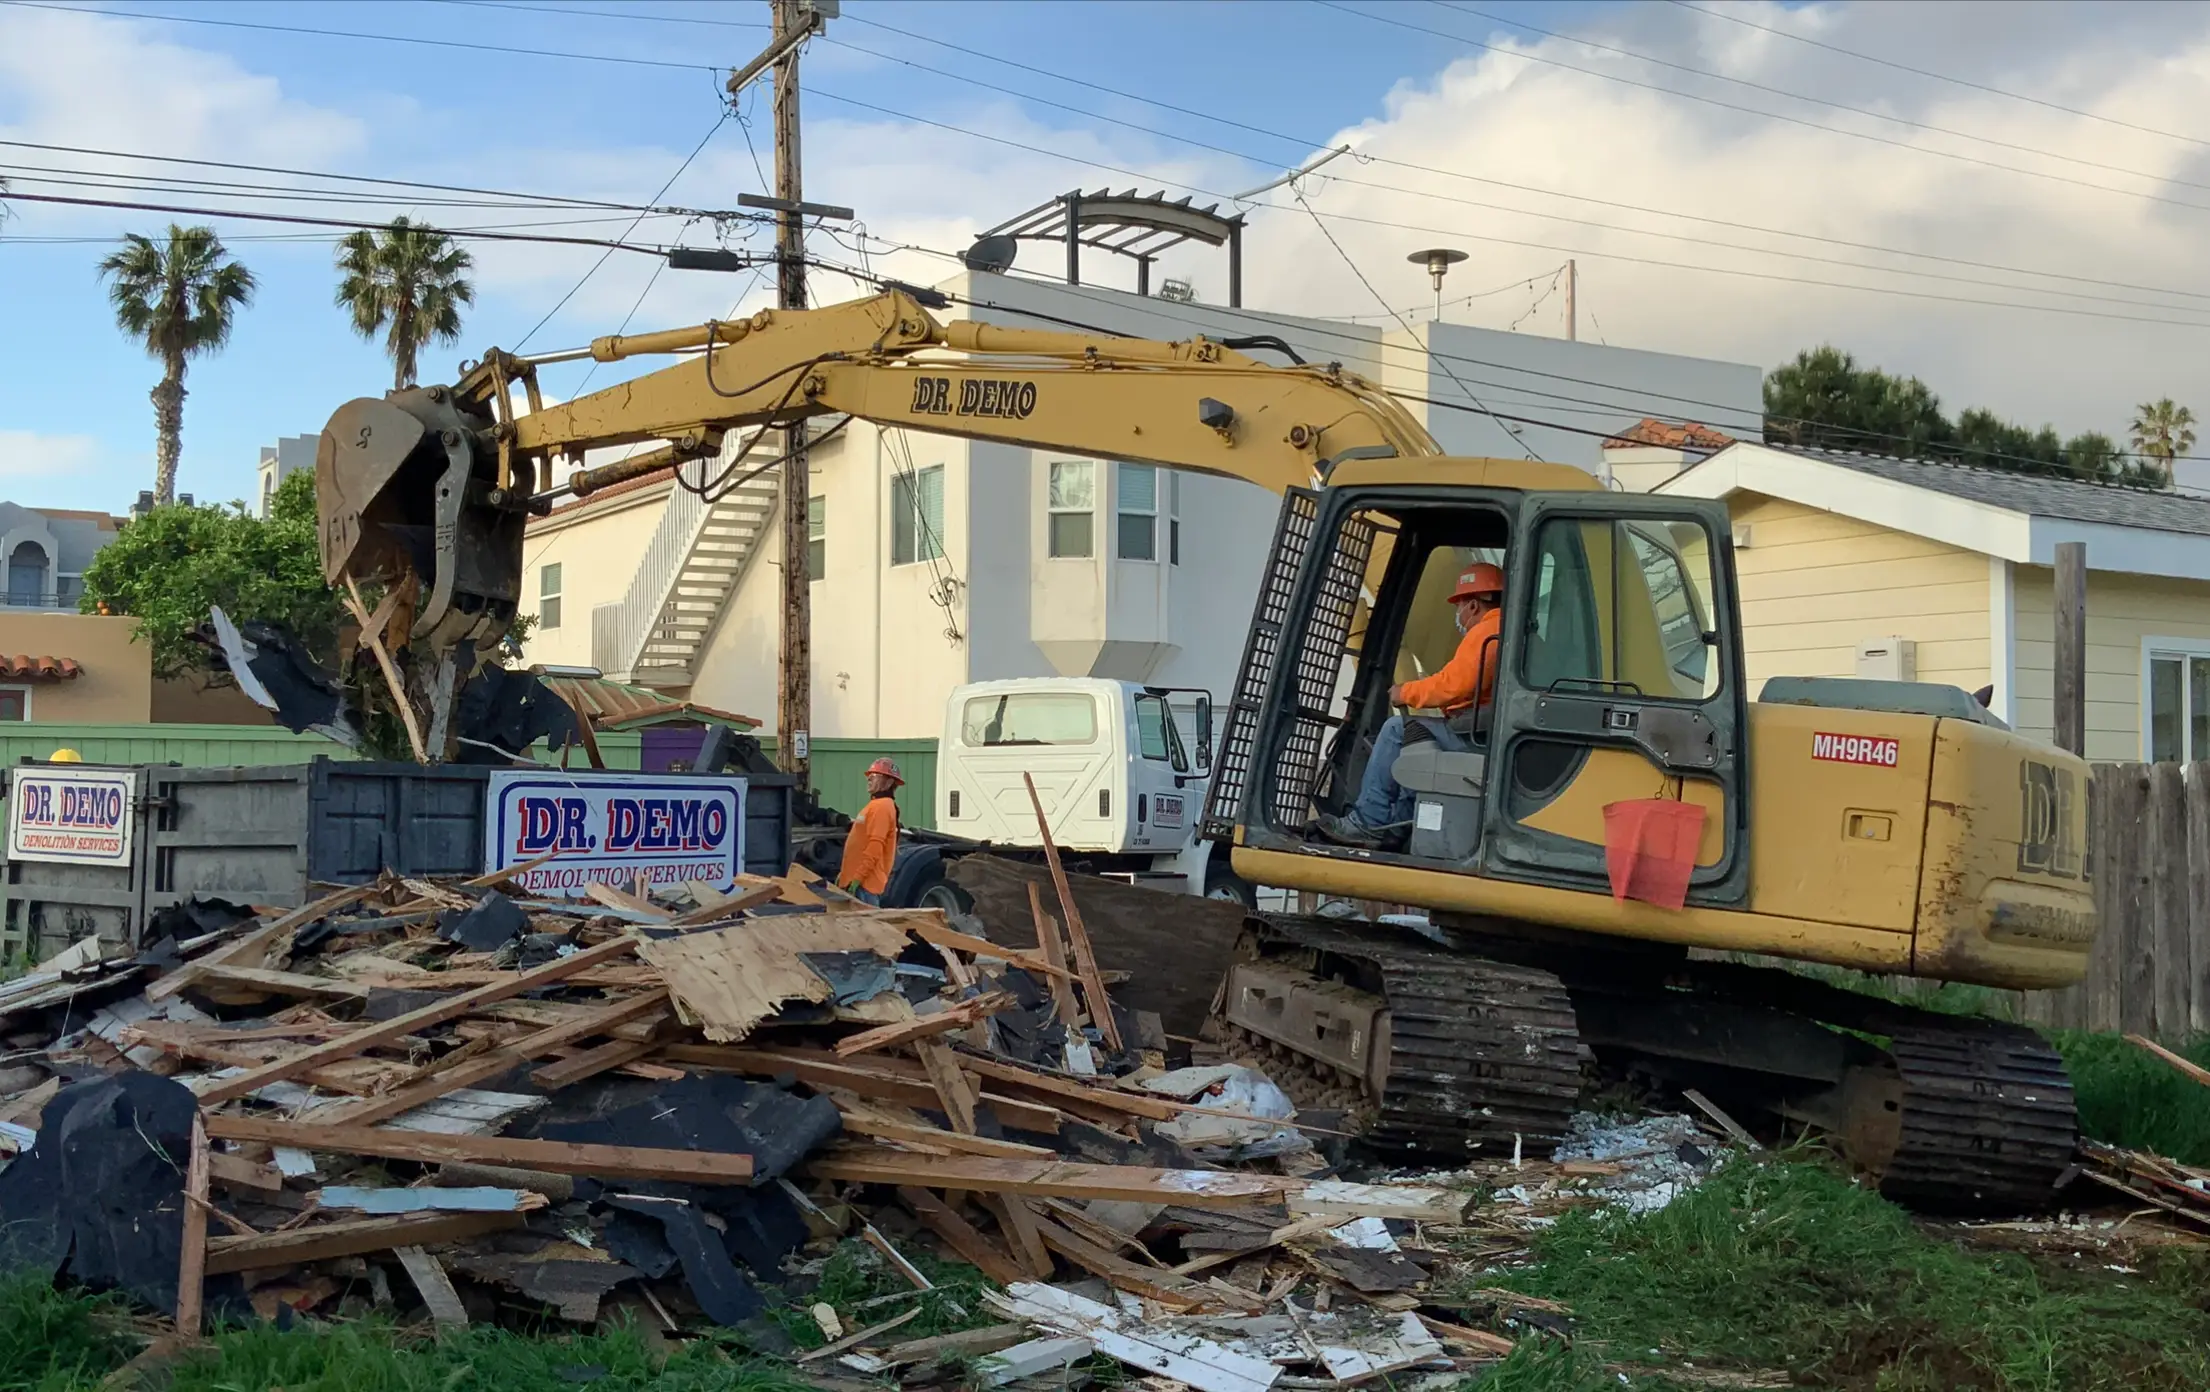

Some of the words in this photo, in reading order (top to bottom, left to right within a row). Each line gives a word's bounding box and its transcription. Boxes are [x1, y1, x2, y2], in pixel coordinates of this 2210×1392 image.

[910, 377, 952, 415] DR.
[956, 379, 1037, 420] DEMO
[1813, 734, 1897, 765] MH9R46
[22, 785, 55, 826] DR.
[59, 786, 121, 829] DEMO
[516, 797, 597, 854] DR.
[604, 797, 728, 852] DEMO
[23, 835, 76, 849] DEMOLITION
[77, 838, 120, 852] SERVICES
[643, 862, 725, 883] SERVICES
